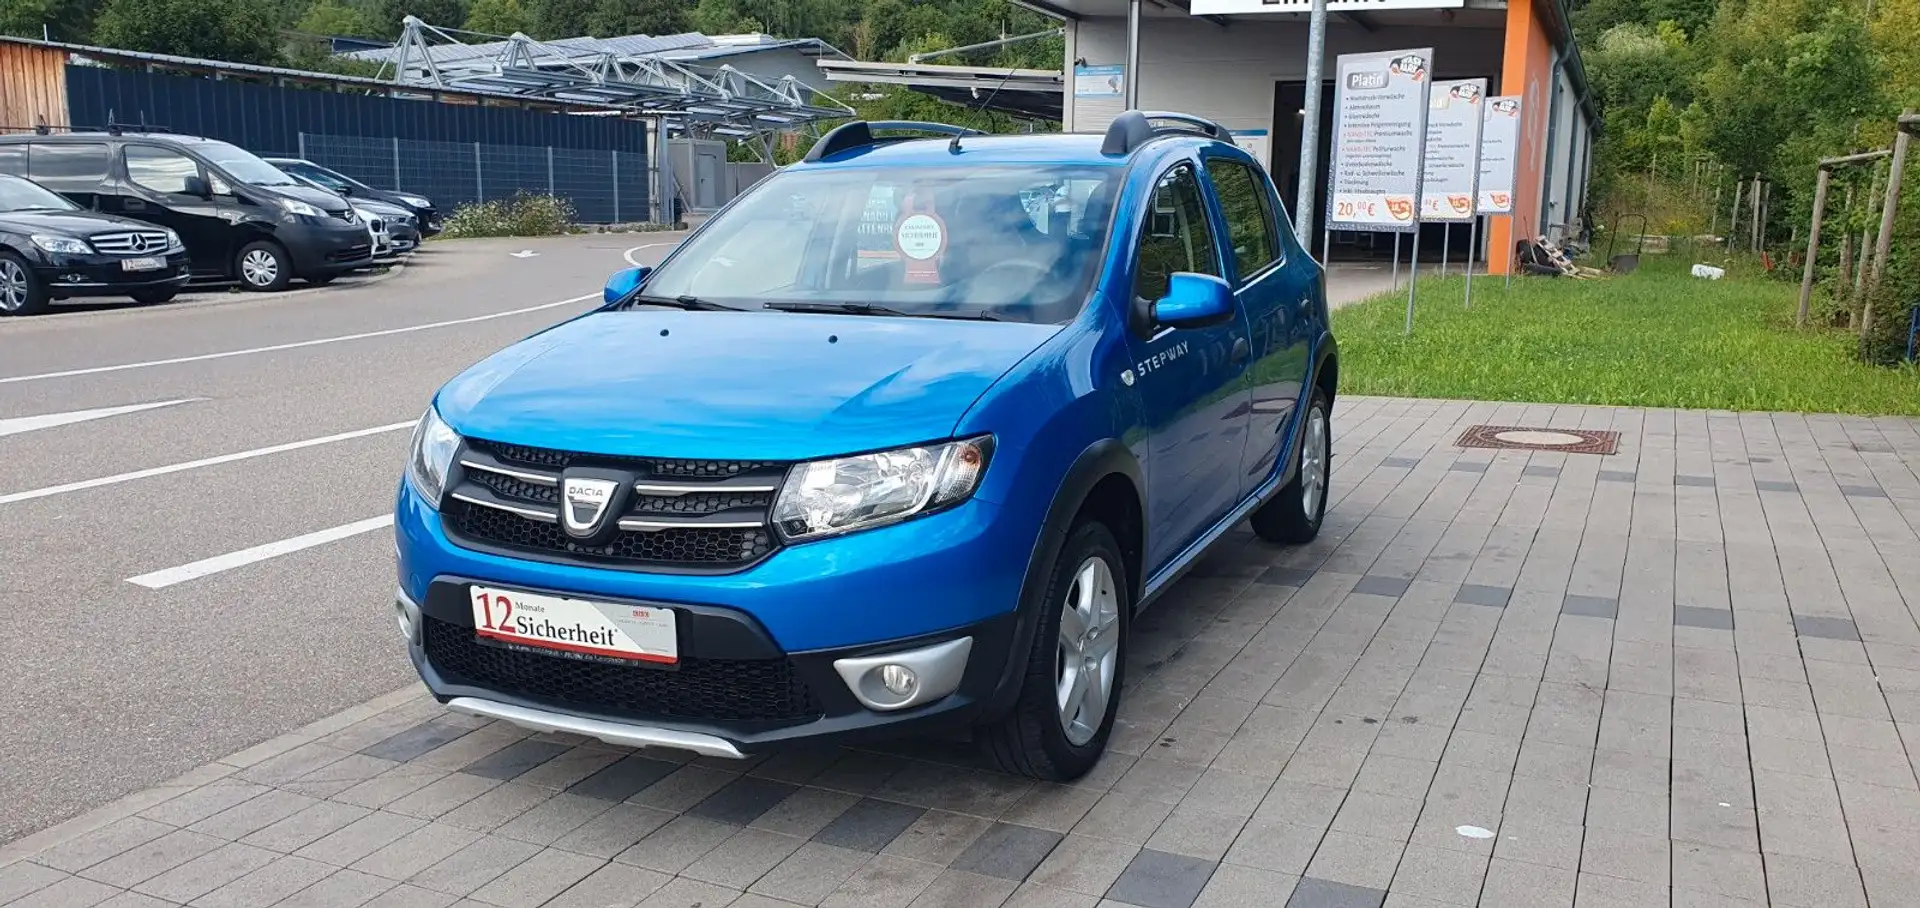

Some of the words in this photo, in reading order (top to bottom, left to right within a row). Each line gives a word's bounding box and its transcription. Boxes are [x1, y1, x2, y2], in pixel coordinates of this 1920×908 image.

[1351, 73, 1384, 87] Platin
[1137, 340, 1189, 377] STEPWAY
[568, 486, 604, 497] DACIA
[476, 592, 516, 635] 12
[514, 601, 545, 614] Monate
